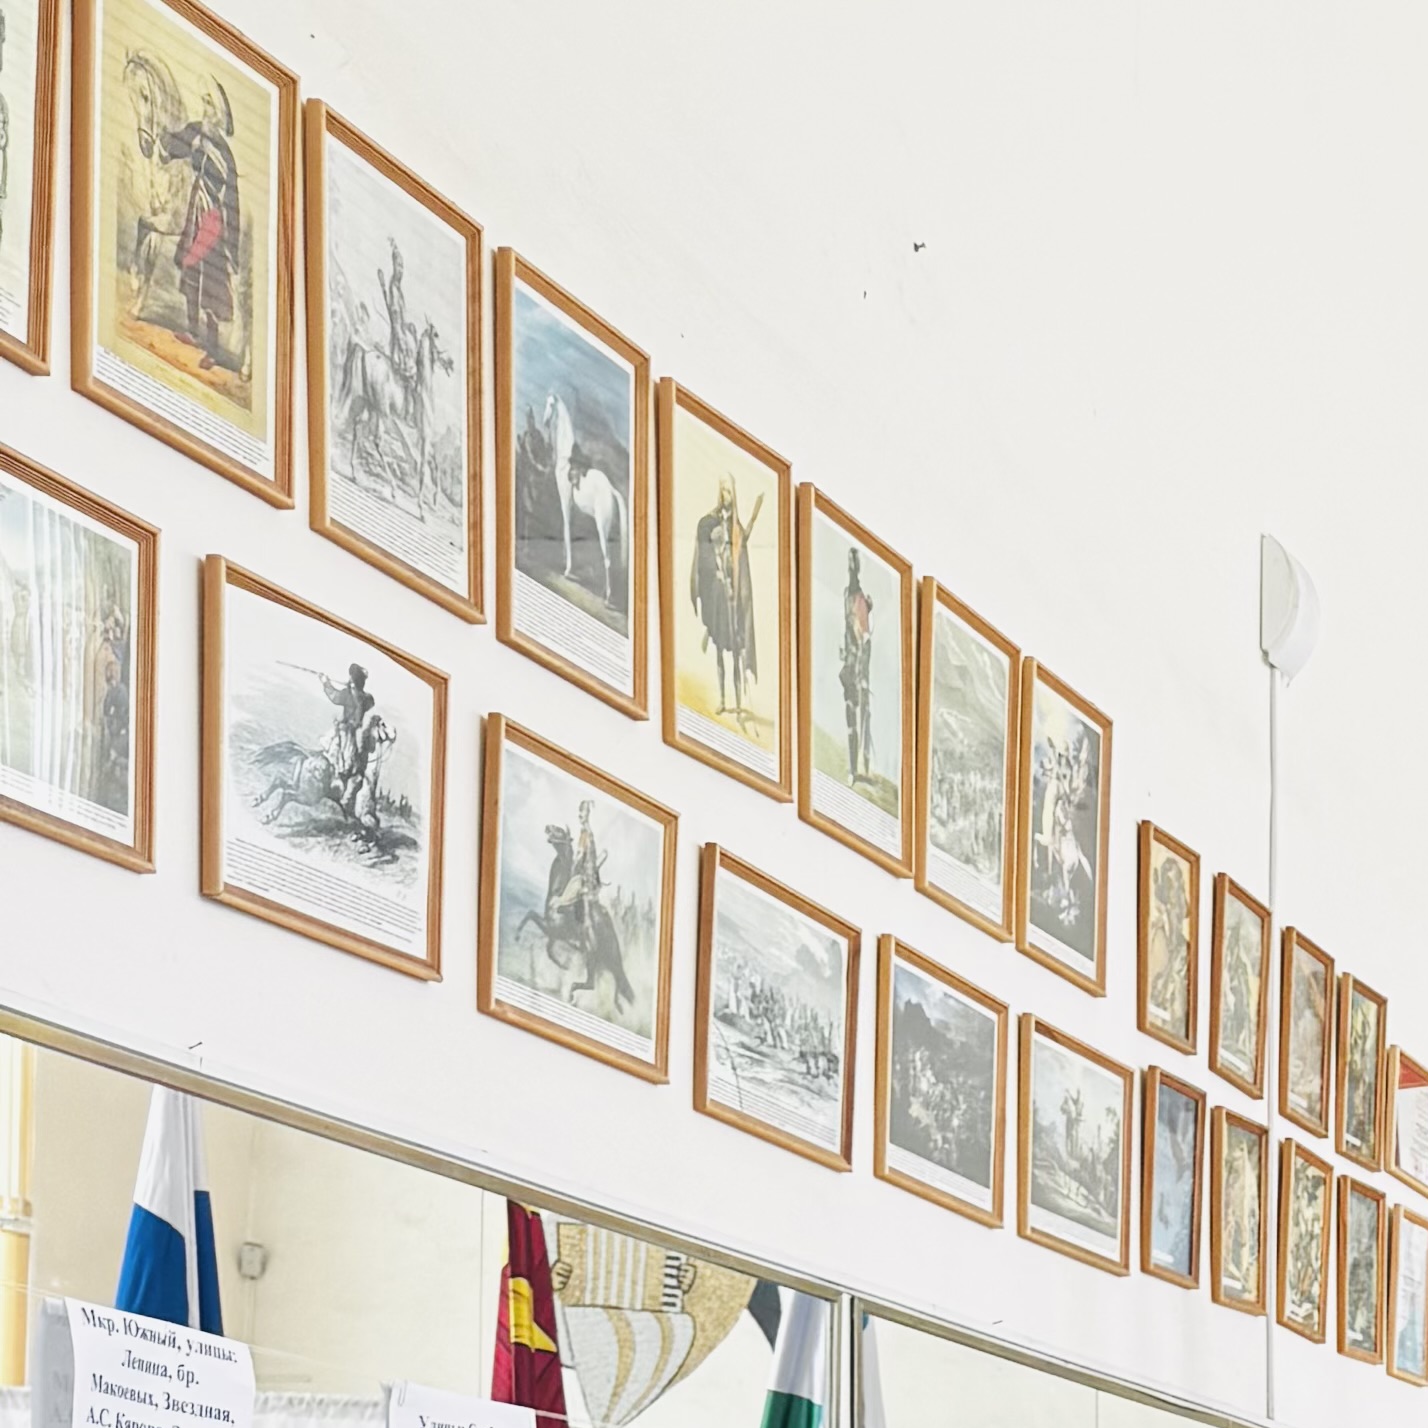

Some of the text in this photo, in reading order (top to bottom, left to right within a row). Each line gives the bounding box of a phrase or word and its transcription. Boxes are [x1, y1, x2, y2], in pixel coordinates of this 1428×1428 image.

[81, 1307, 238, 1363] Мкр. Южный, улицы:
[121, 1350, 199, 1389] Ленина, бр.
[86, 1406, 111, 1428] А.С.
[91, 1373, 159, 1410] Макоевых,
[162, 1391, 235, 1426] Звездная,
